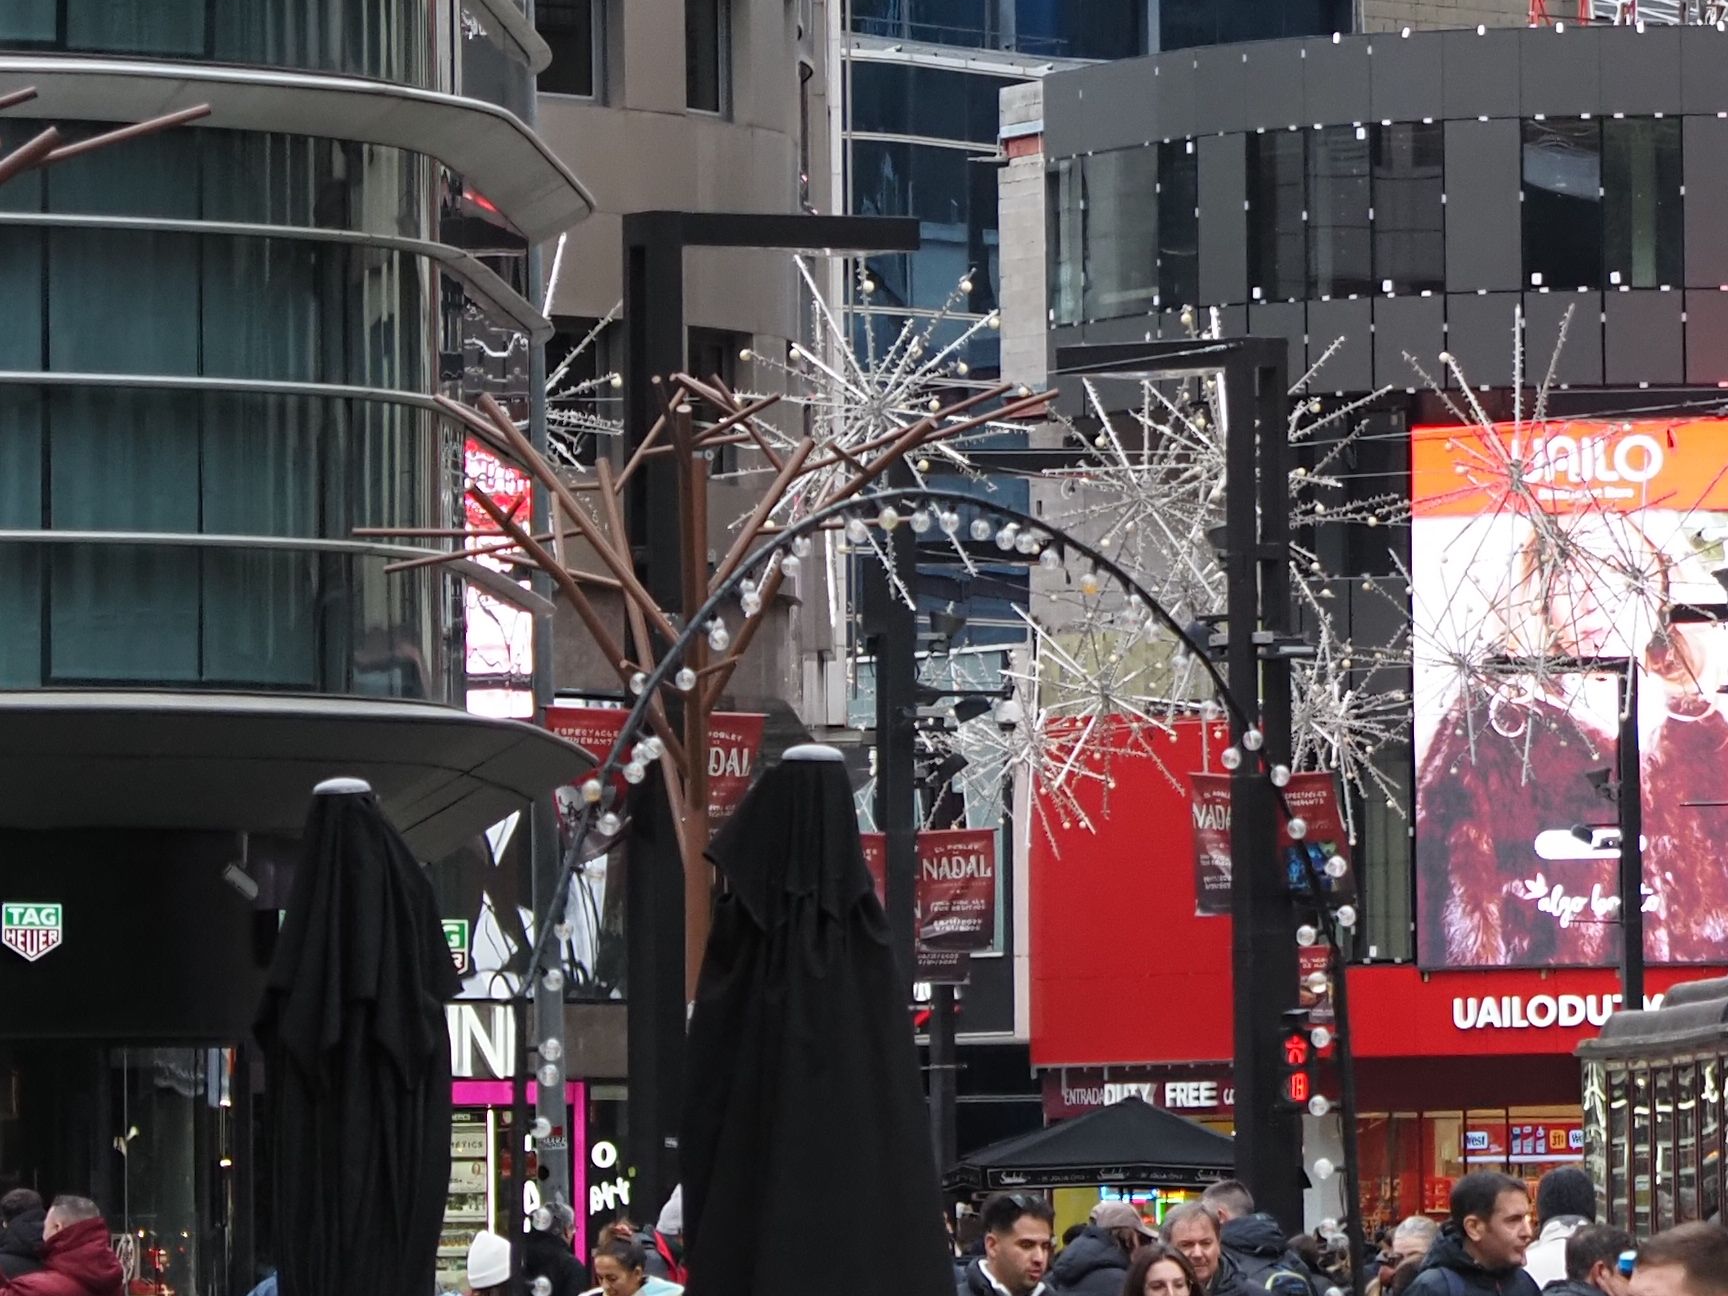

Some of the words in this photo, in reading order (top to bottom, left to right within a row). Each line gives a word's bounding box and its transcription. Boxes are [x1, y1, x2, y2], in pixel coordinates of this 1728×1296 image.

[1511, 434, 1664, 483] UAILO
[921, 854, 992, 882] NADAL
[7, 907, 58, 926] TAG
[5, 929, 59, 959] HEUER
[1165, 1080, 1218, 1108] FREE
